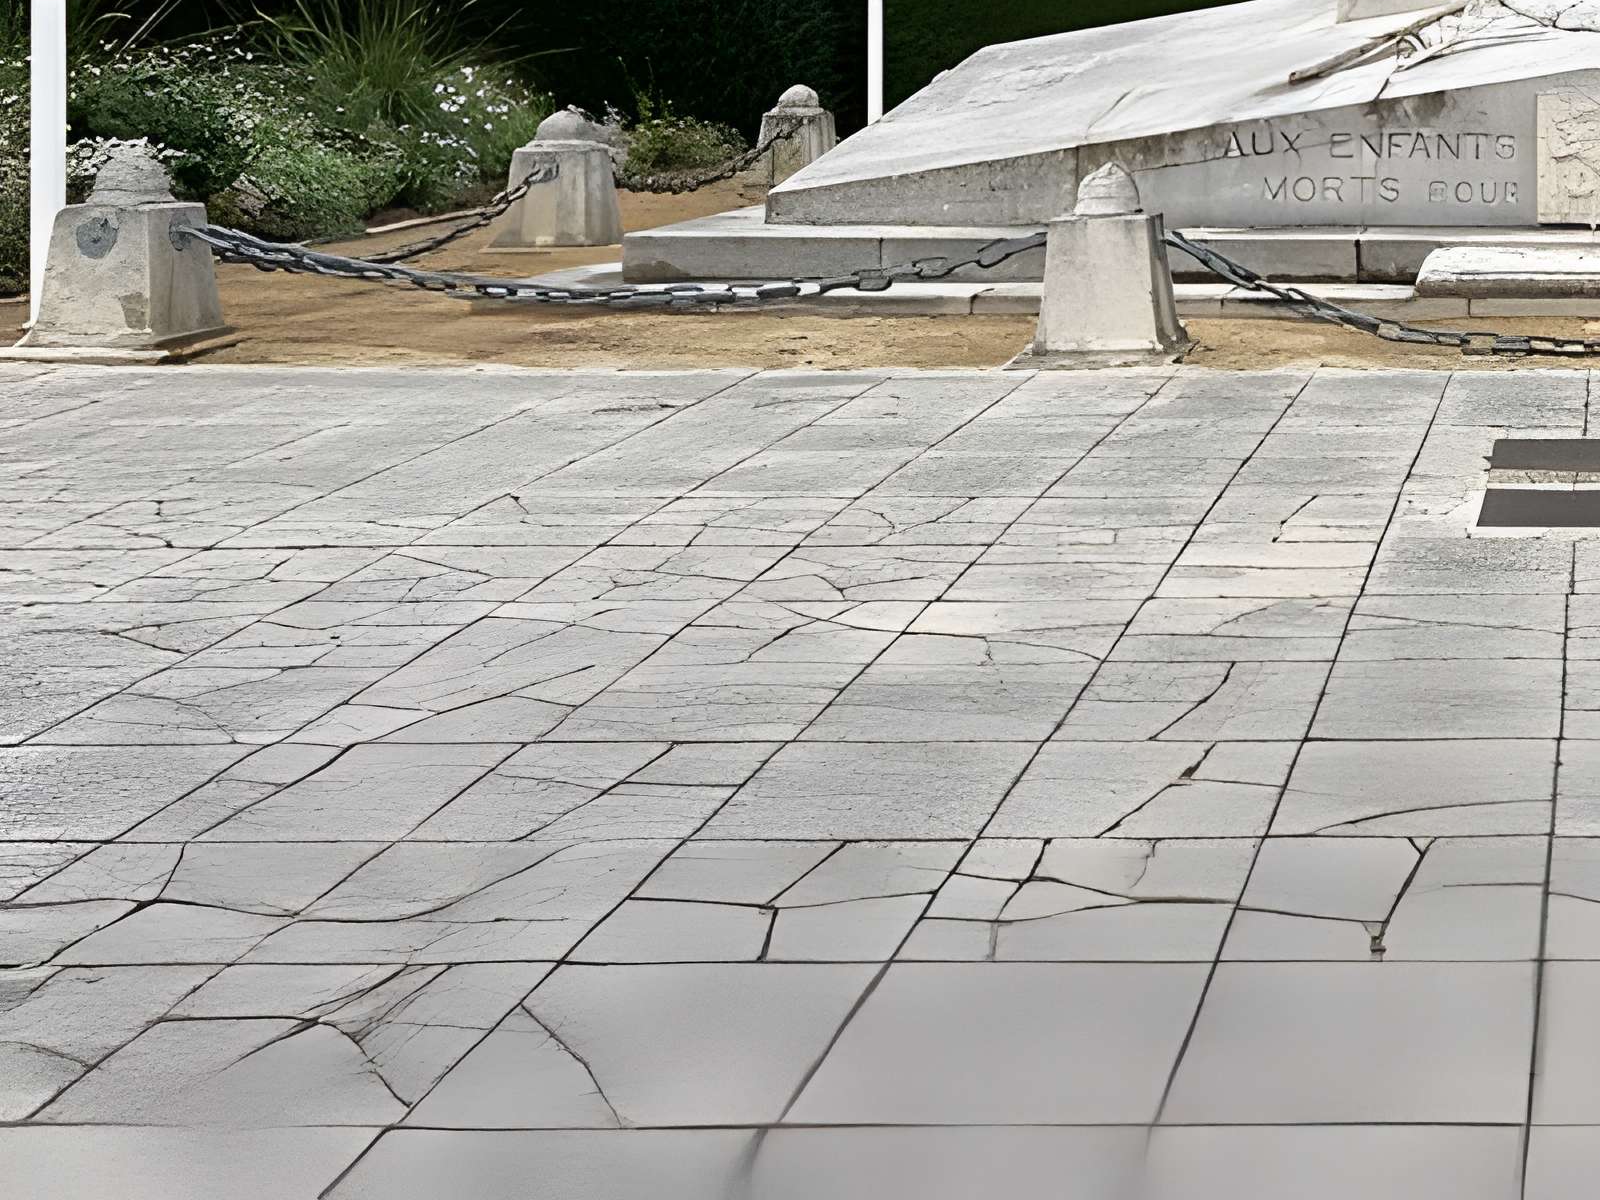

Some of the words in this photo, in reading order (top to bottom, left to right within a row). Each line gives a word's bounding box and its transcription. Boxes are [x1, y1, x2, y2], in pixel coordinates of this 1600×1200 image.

[1222, 131, 1302, 158] AUX
[1329, 132, 1516, 160] ENFANTS
[1263, 176, 1400, 203] MORTS
